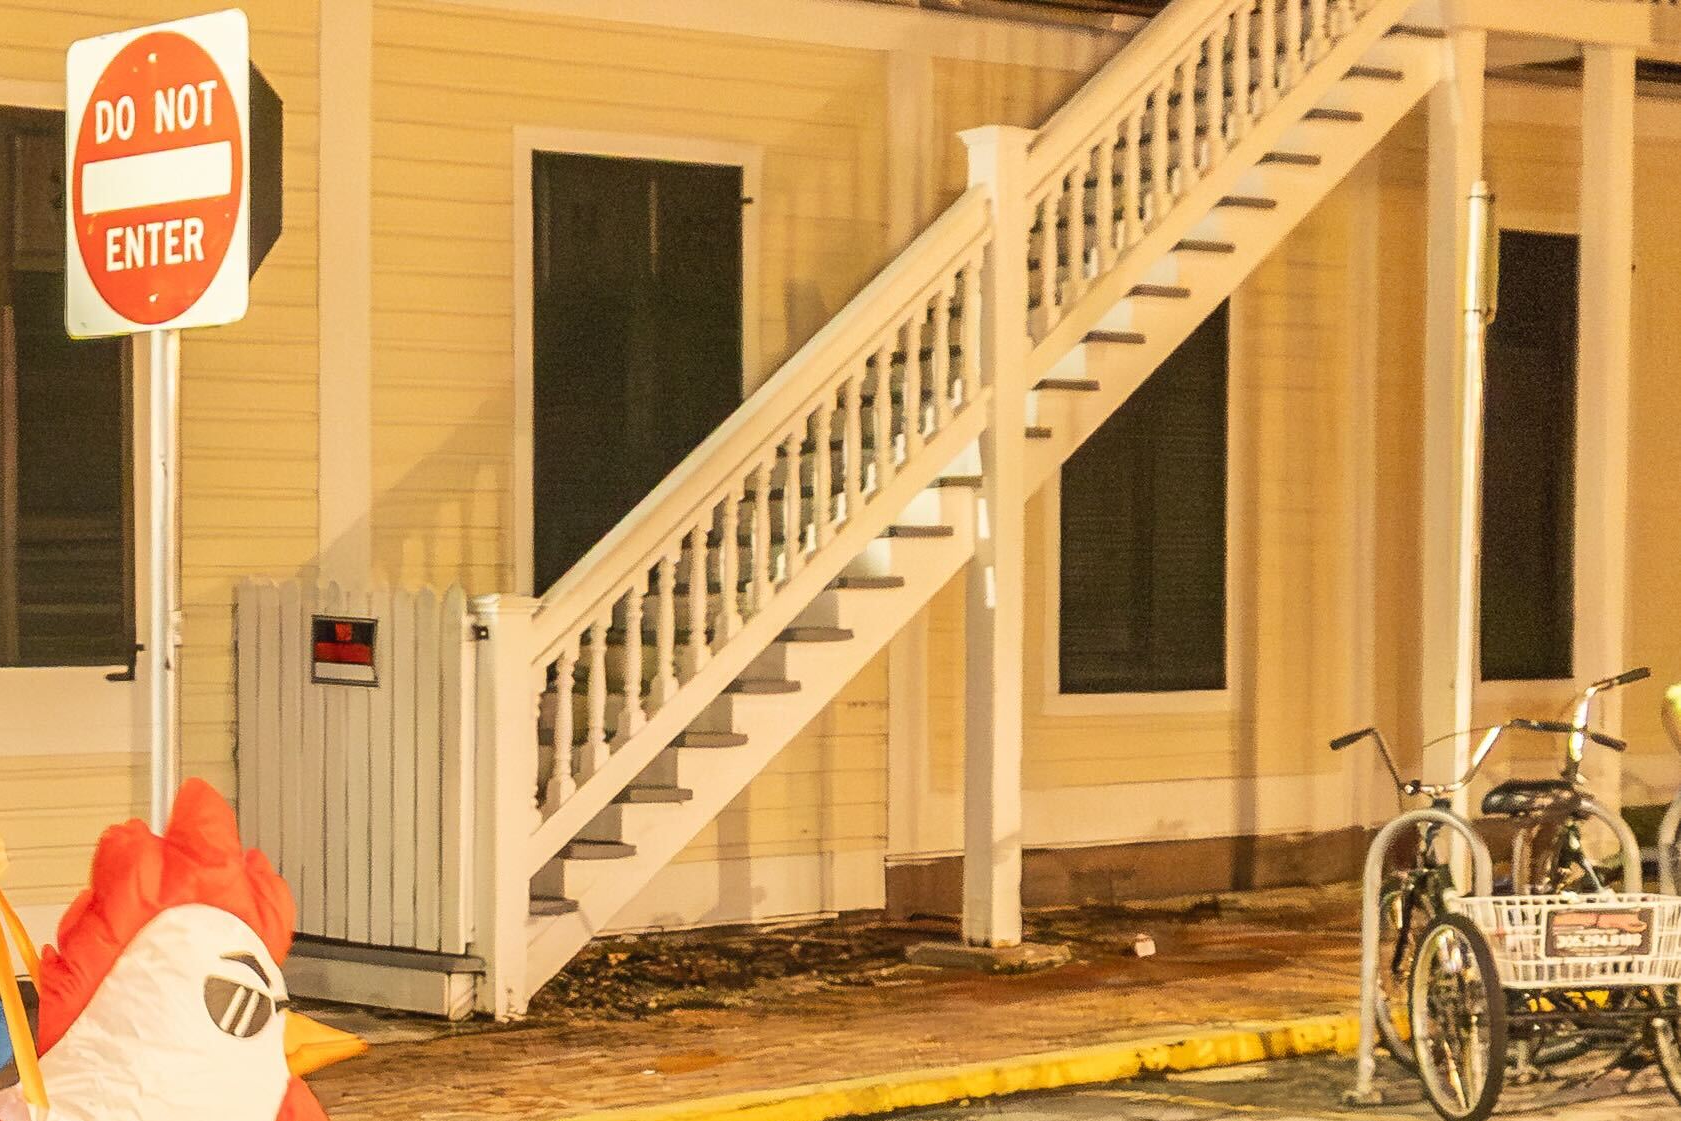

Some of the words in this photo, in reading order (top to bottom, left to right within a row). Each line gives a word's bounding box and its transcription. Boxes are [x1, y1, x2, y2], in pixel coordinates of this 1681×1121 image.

[94, 95, 136, 144] DO
[154, 80, 218, 134] NOT
[105, 217, 205, 272] ENTER
